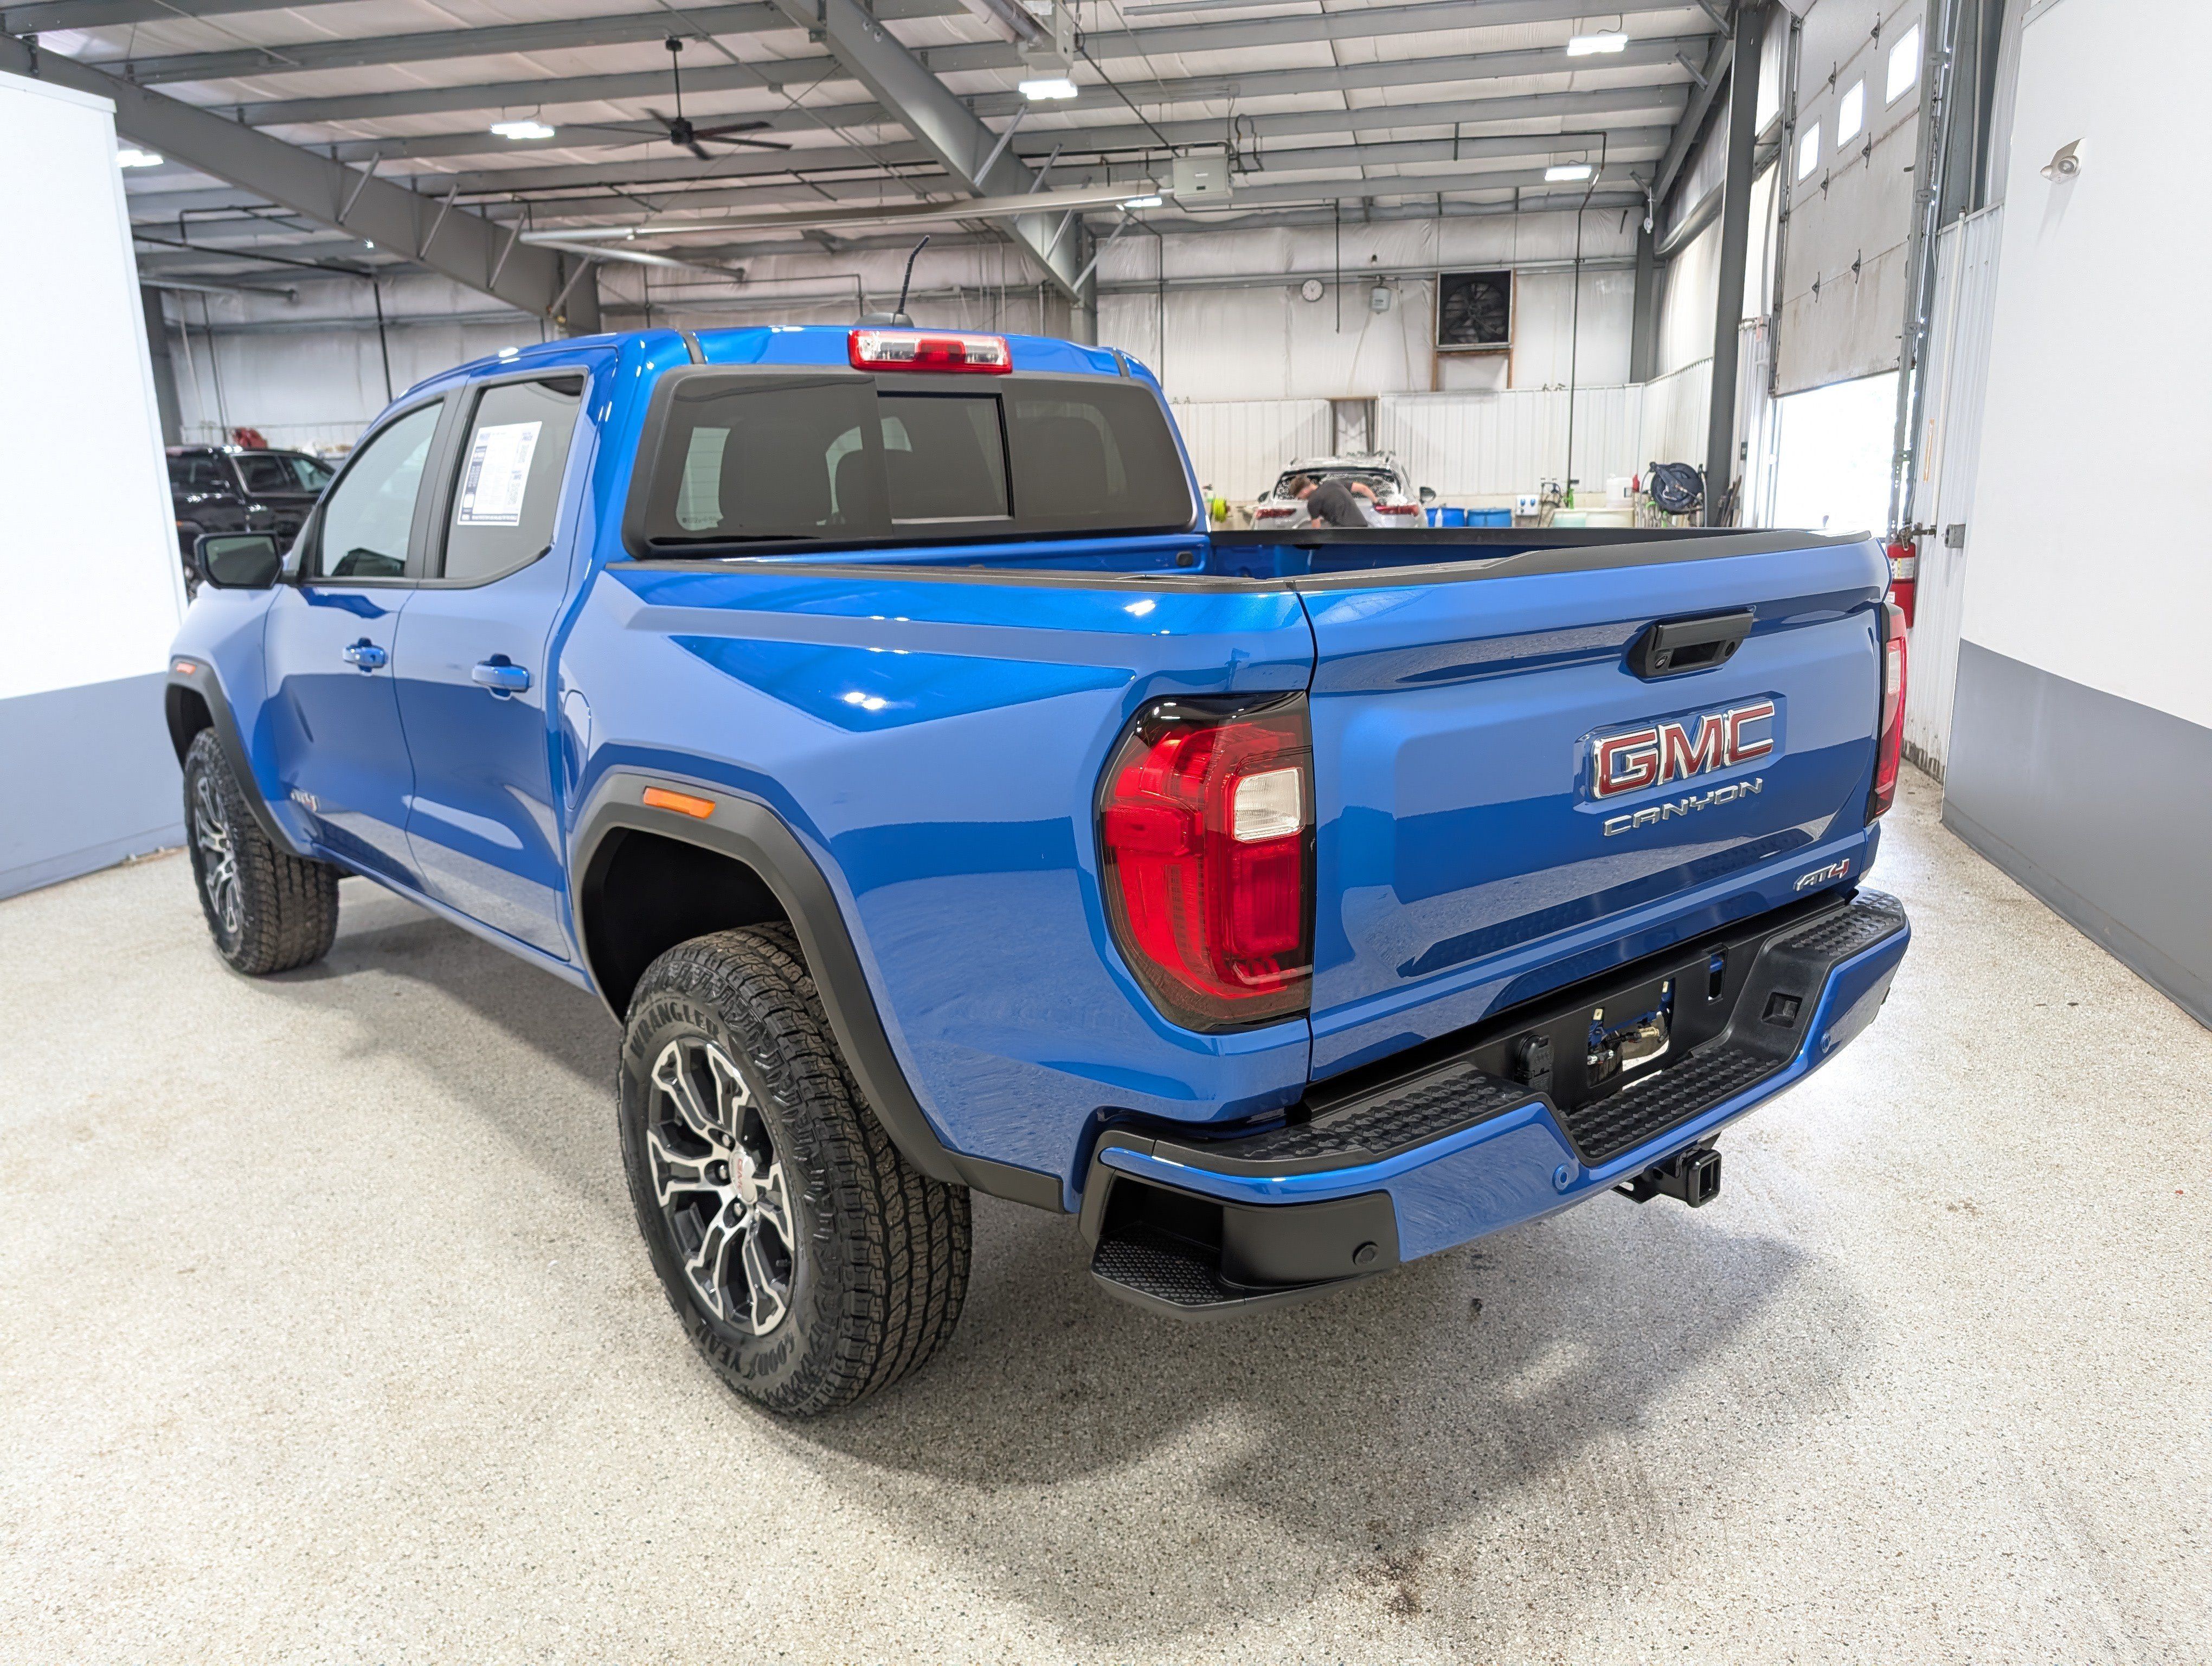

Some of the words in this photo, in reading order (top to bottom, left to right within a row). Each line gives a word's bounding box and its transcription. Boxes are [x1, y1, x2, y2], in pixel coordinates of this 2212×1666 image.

[1593, 700, 1775, 800] GMC
[1603, 778, 1763, 837] CANYON
[1795, 858, 1850, 892] AT4
[630, 1002, 719, 1059] WRANGLER
